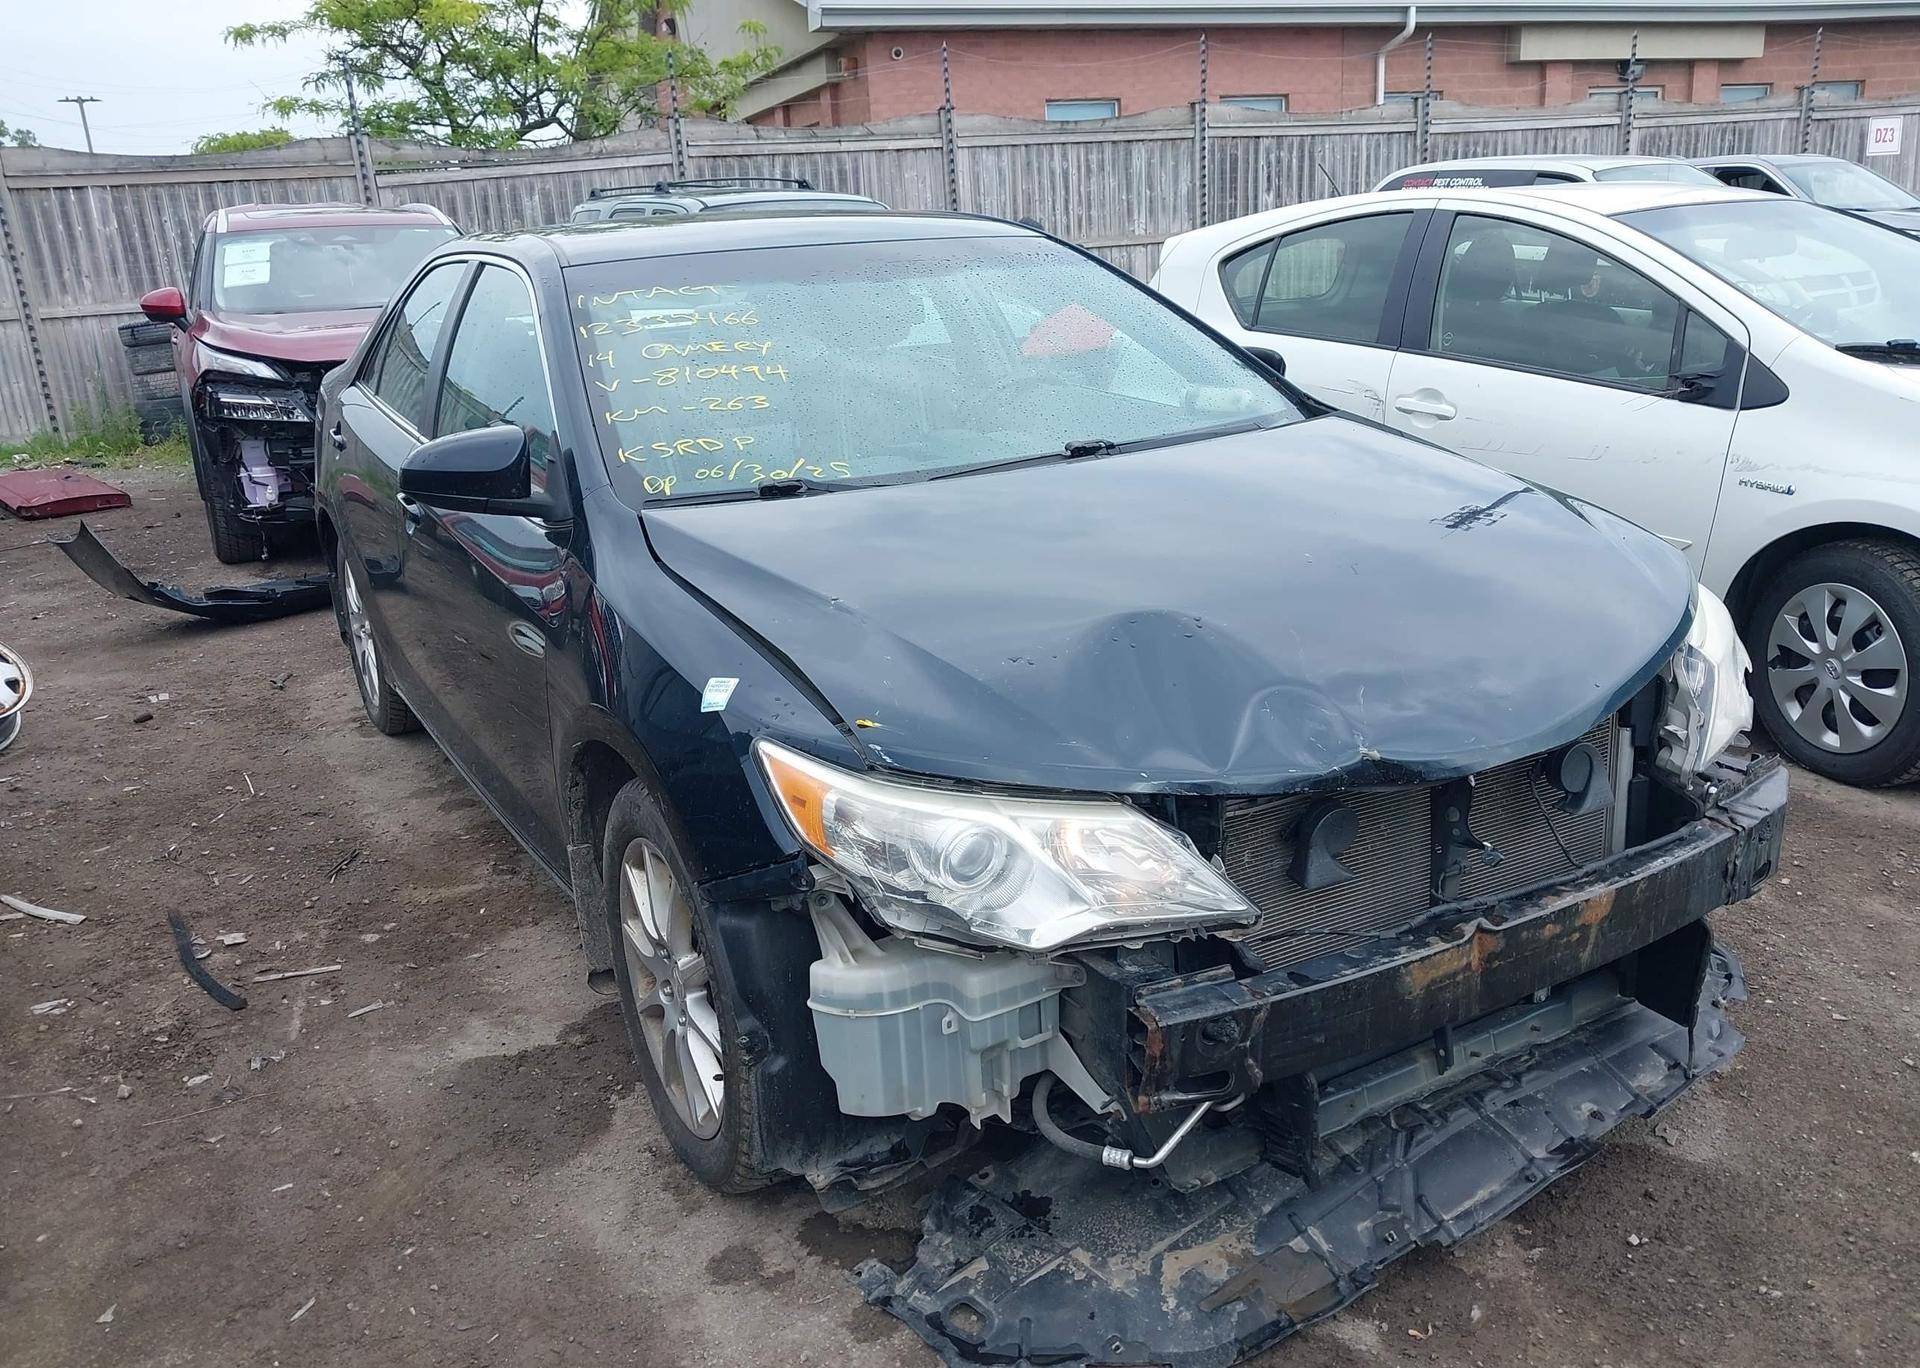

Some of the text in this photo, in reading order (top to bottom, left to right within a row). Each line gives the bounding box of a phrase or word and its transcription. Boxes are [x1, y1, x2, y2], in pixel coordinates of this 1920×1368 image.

[1875, 127, 1895, 144] DZ3
[1433, 178, 1450, 186] PEST
[1450, 177, 1483, 186] CONTROL
[578, 285, 737, 308] INTACT
[588, 350, 615, 368] 14
[1738, 478, 1786, 495] HYBRID
